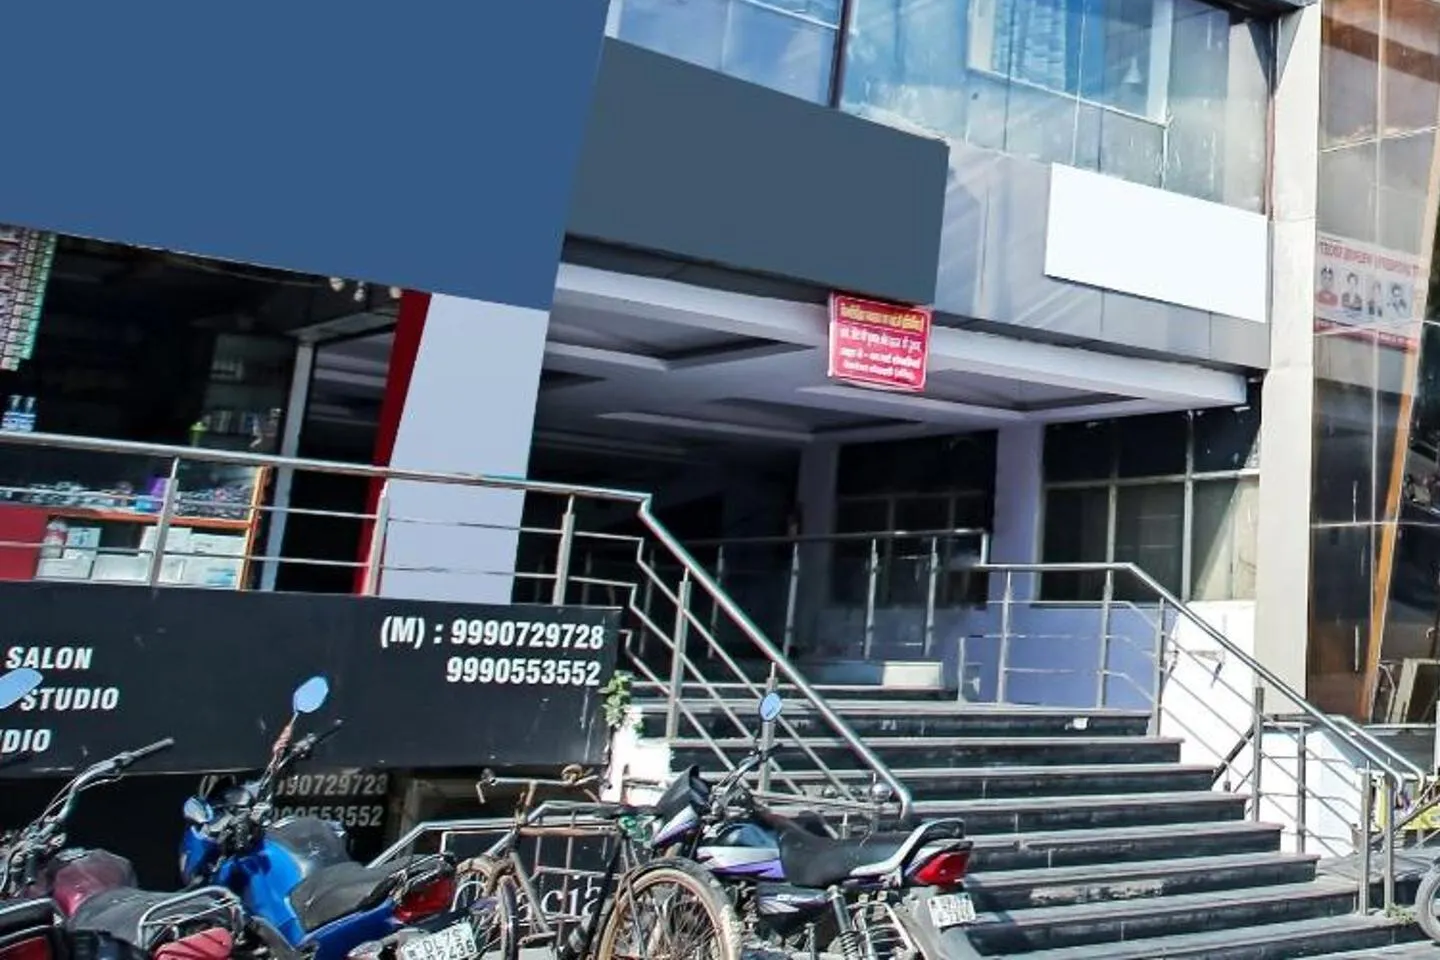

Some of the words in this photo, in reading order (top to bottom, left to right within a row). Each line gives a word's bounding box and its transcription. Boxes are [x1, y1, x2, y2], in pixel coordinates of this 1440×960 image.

[380, 616, 426, 648] (M)
[450, 618, 605, 649] 9990729728
[5, 646, 93, 670] SALON
[446, 656, 602, 686] 9990553552
[20, 686, 120, 712] STUDIO
